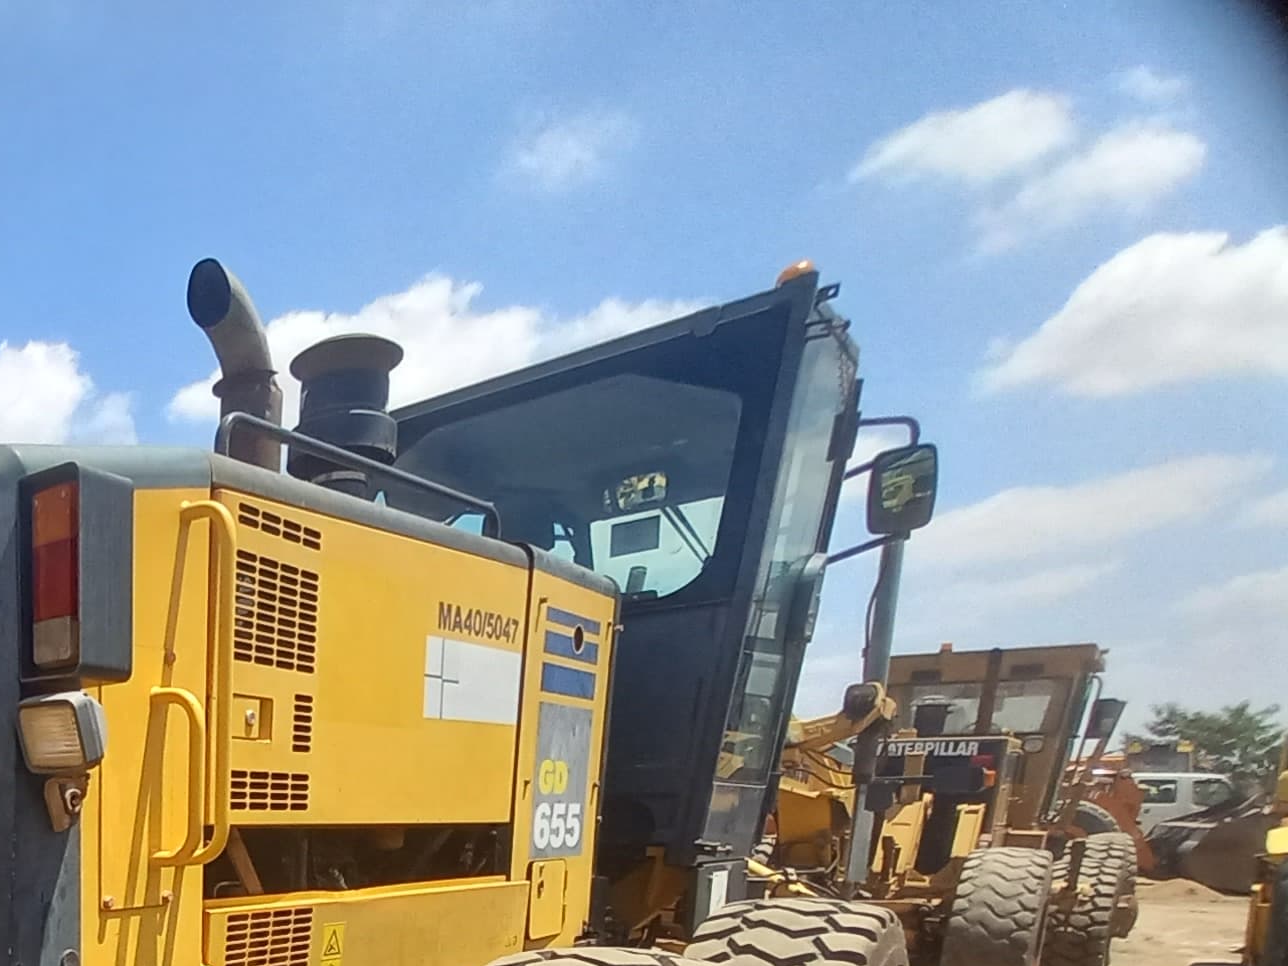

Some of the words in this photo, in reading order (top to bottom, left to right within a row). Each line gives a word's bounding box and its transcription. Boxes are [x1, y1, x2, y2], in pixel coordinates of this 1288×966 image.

[437, 601, 520, 644] MA40/5047
[538, 759, 568, 795] GD
[532, 802, 583, 850] 655
